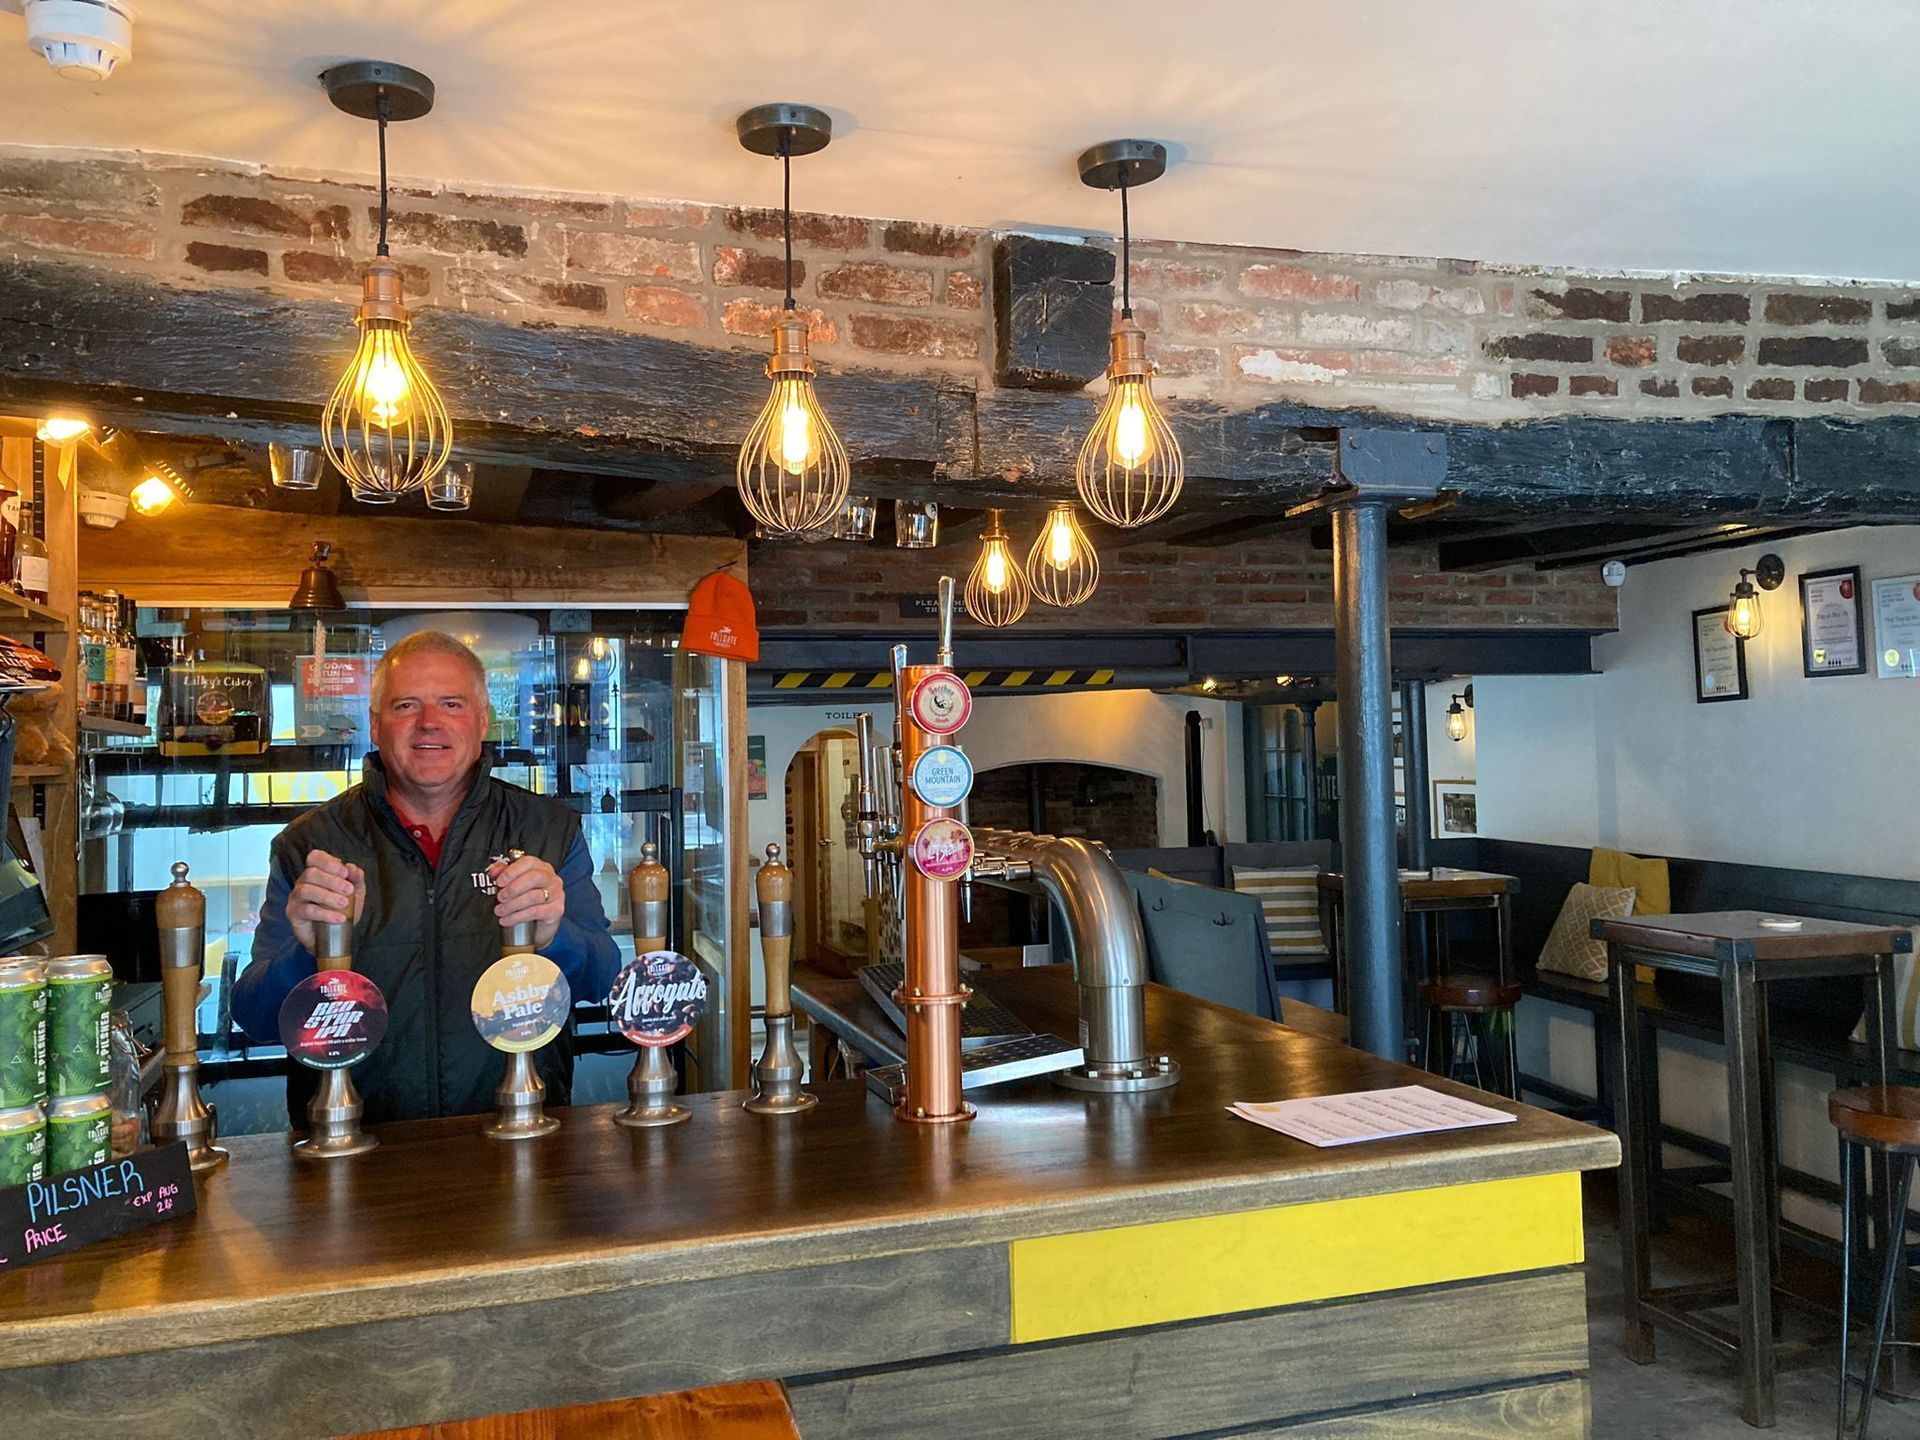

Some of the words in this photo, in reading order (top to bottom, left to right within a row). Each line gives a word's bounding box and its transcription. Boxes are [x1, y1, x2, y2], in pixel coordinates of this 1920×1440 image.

[925, 775, 961, 785] MOUNTAIN
[931, 767, 954, 776] GREEN
[471, 873, 497, 888] TOL
[492, 984, 549, 1007] Ashby
[311, 1000, 357, 1018] RED
[503, 1001, 543, 1020] Pale
[303, 1011, 364, 1029] STAR
[100, 1011, 110, 1056] PILSNER
[313, 1023, 353, 1039] IPA
[37, 1020, 46, 1066] PILSNER
[27, 1160, 144, 1223] PILSNER
[133, 1191, 153, 1207] EXP
[158, 1183, 179, 1198] AUG
[156, 1198, 174, 1213] 24
[24, 1223, 68, 1254] PRICE
